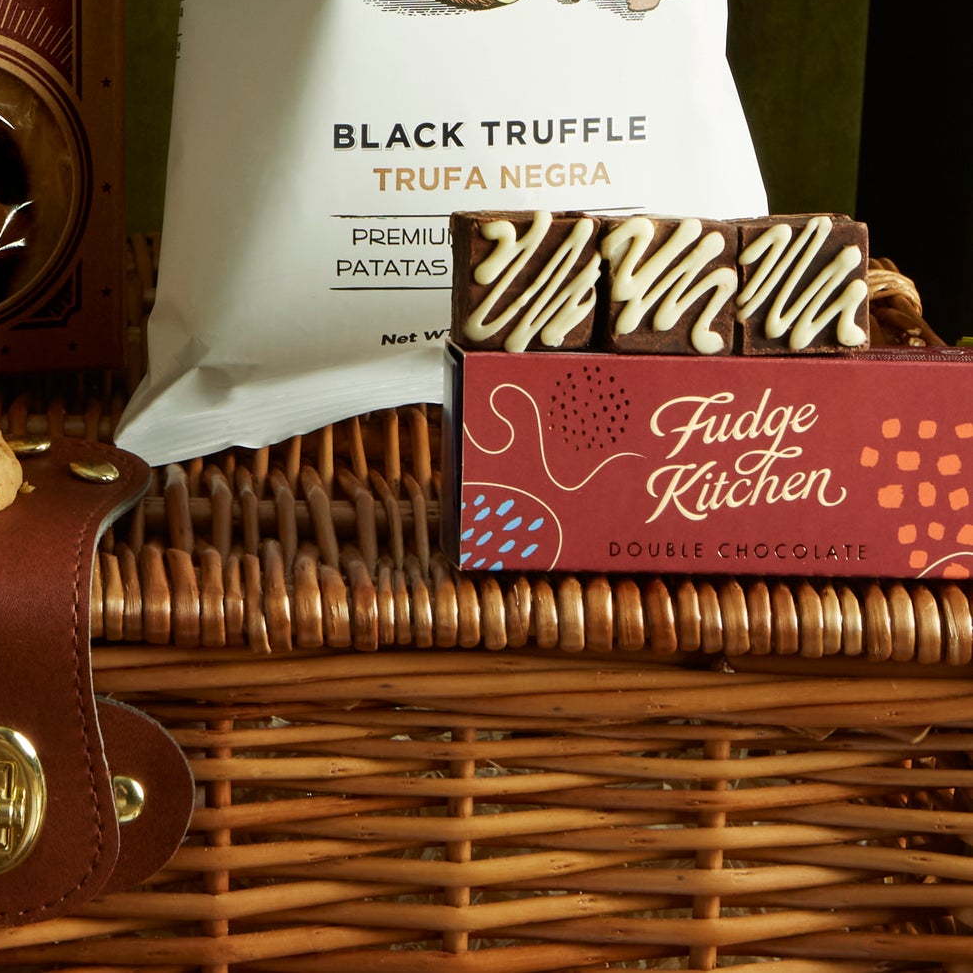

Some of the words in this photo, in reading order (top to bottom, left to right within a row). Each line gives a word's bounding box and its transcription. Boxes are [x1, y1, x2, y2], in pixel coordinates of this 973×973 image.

[333, 122, 465, 149] BLACK
[481, 116, 647, 146] TRUFFLE
[373, 166, 488, 191] TRUFA
[501, 162, 611, 189] NEGRA
[336, 259, 448, 277] PATATAS
[381, 333, 417, 345] Net
[650, 387, 819, 476] Fudge
[646, 461, 847, 524] Kitchen
[609, 542, 704, 558] DOUBLE
[718, 543, 867, 560] CHOCOLATE
